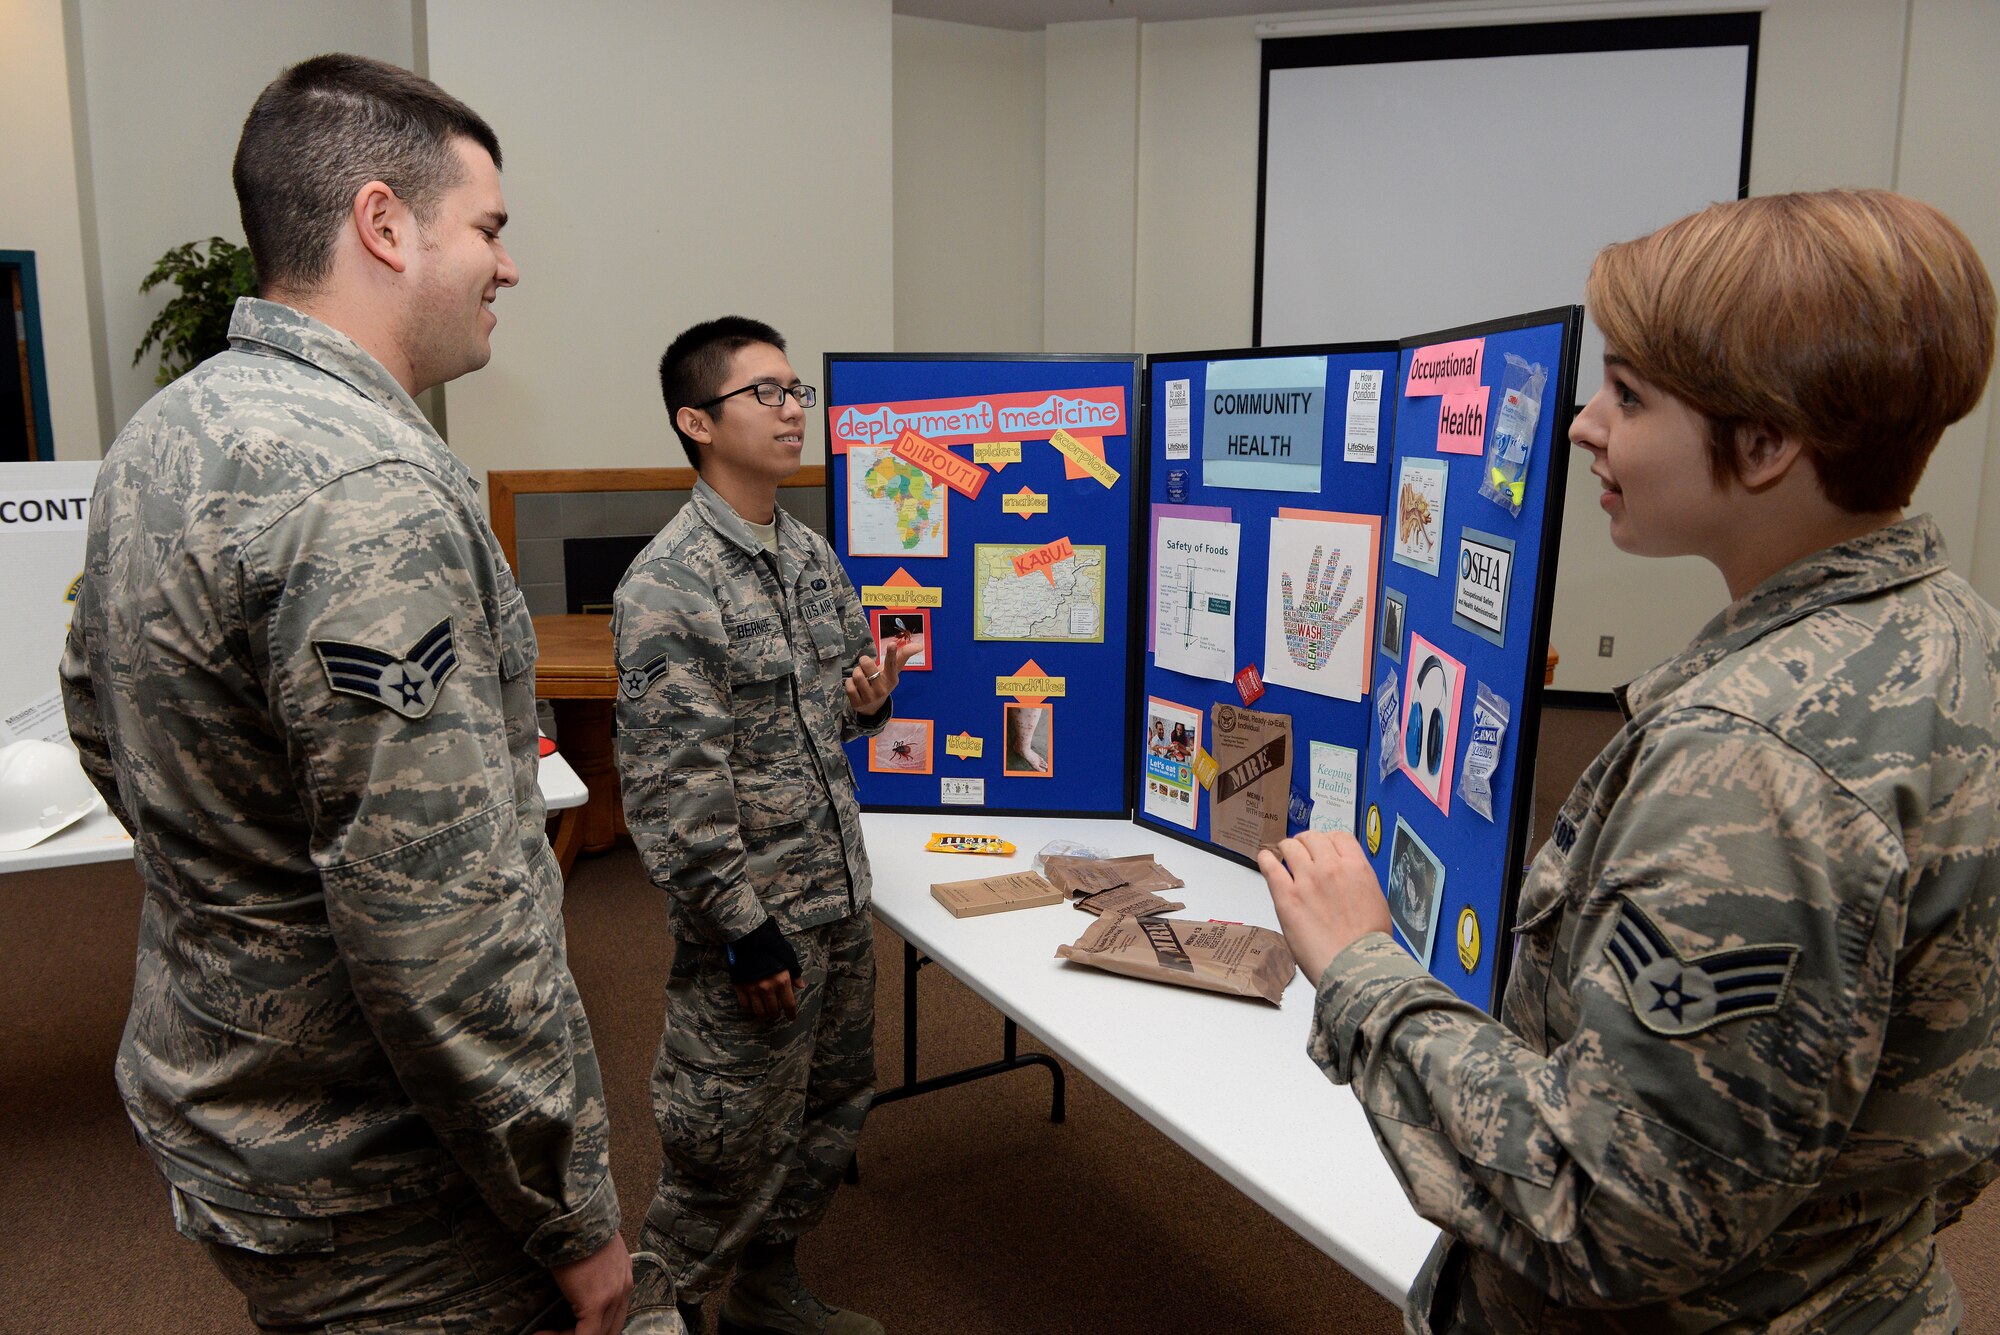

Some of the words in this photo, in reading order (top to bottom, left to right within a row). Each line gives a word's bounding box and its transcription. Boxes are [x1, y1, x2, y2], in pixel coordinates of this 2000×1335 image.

[1411, 350, 1478, 384] Occupational
[1354, 381, 1360, 390] to
[1360, 372, 1374, 382] How
[1214, 392, 1312, 415] COMMUNITY
[1353, 390, 1376, 402] Condom
[837, 404, 992, 445] deployment
[1001, 399, 1117, 429] medicine
[1440, 404, 1483, 436] Health
[975, 442, 1020, 461] spiders
[1168, 443, 1188, 451] LifeStyles
[1228, 435, 1292, 457] HEALTH
[1347, 443, 1375, 452] LifeStyles
[901, 436, 979, 489] DJIBOUTI
[1054, 431, 1117, 483] scorpions
[0, 497, 93, 523] CONT
[1004, 497, 1048, 507] snakes
[1167, 540, 1192, 553] Safety
[1195, 543, 1203, 552] of
[1206, 544, 1229, 555] Foods
[1016, 543, 1073, 574] KABUL
[1461, 548, 1500, 592] OSHA
[864, 591, 938, 606] mosquitoes
[1463, 588, 1482, 602] Occupational
[1483, 597, 1494, 608] Safety
[1310, 602, 1328, 613] SOAP
[1463, 600, 1473, 610] Health
[1474, 604, 1498, 621] Administration
[1297, 623, 1322, 640] WASH
[1308, 641, 1317, 670] CLEAN
[997, 679, 1065, 694] sandflies
[1238, 723, 1260, 732] Individual
[948, 735, 981, 751] ticks
[1150, 759, 1164, 770] Let's
[1166, 765, 1176, 774] eat
[1229, 747, 1272, 791] MRE
[1317, 763, 1352, 783] Keeping
[1247, 791, 1260, 801] MENU
[1317, 778, 1352, 797] Healthy
[1246, 799, 1259, 809] CHILI
[1246, 807, 1258, 816] WITH
[1258, 811, 1279, 821] BEANS
[1184, 933, 1197, 945] MENU
